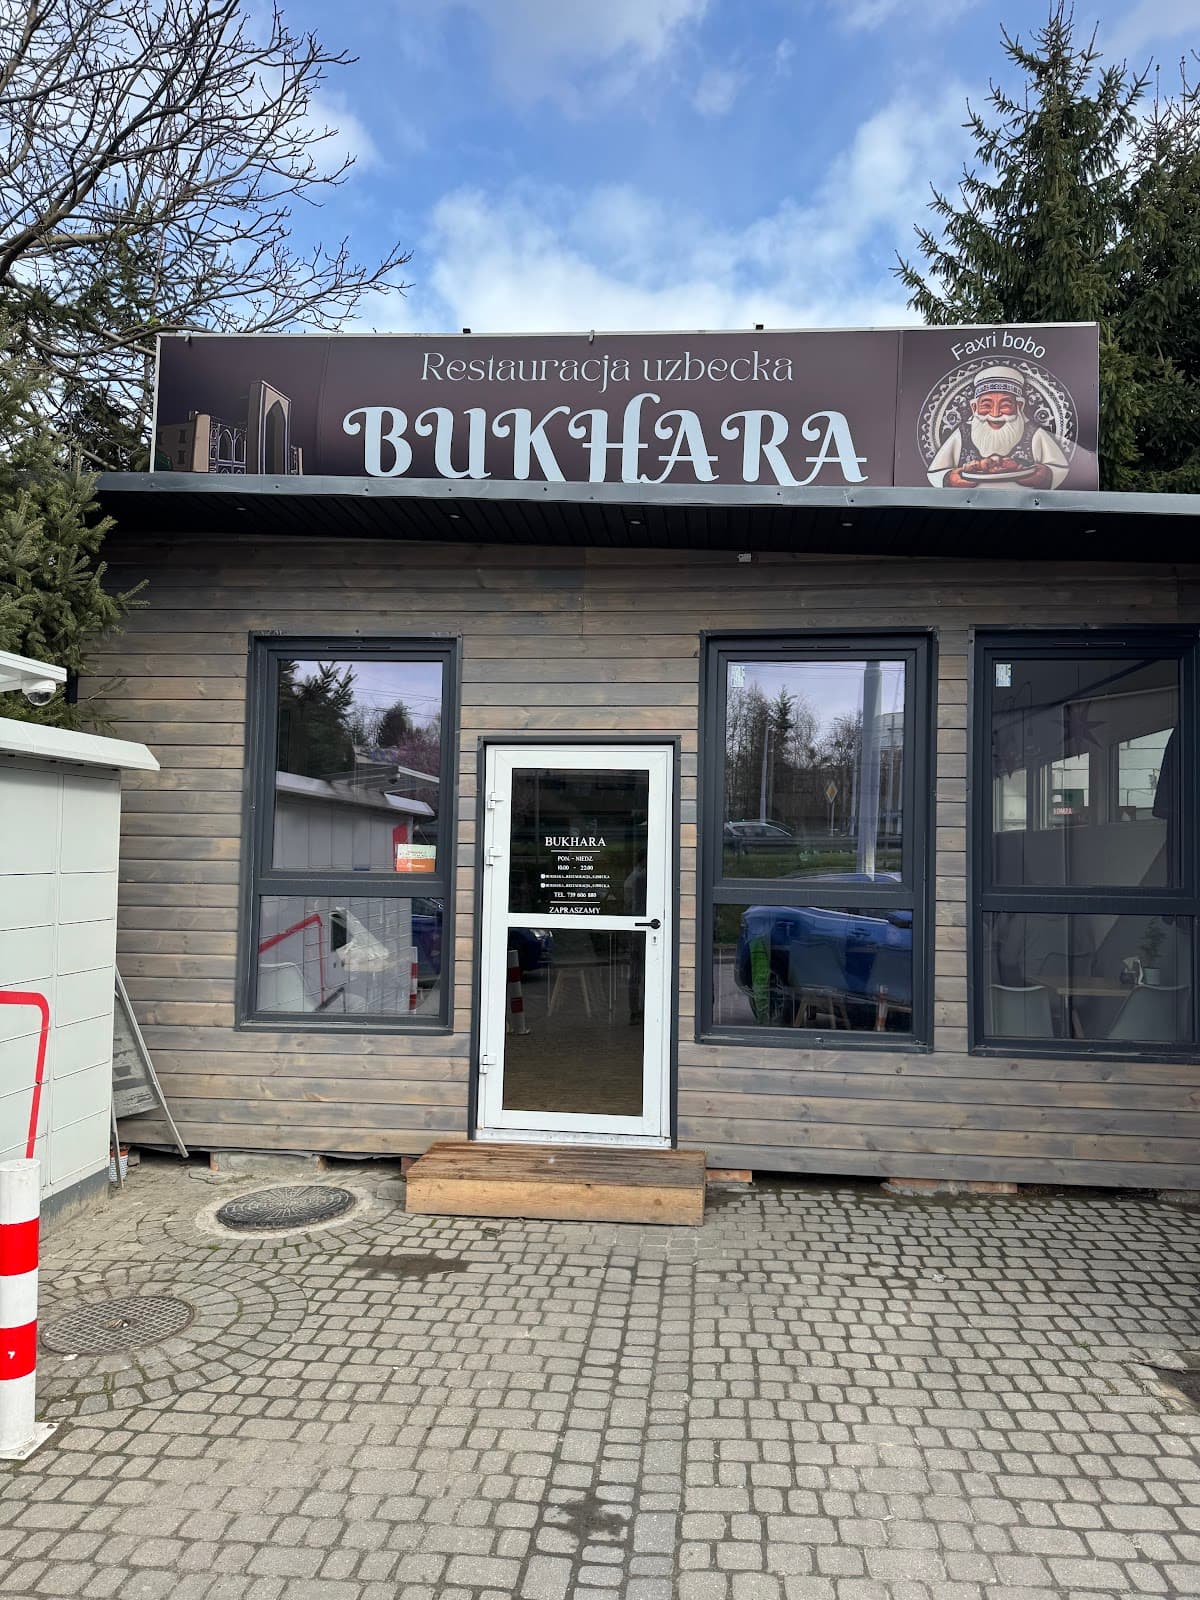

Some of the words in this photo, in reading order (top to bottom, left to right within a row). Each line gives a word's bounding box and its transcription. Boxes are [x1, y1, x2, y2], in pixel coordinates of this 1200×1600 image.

[951, 332, 997, 361] Faxri
[1002, 331, 1046, 359] bobo
[421, 351, 631, 393] Restauracja
[642, 350, 794, 382] uzbecka
[342, 392, 869, 487] BUKHARA
[544, 836, 606, 847] BUKHARA
[549, 906, 601, 914] ZAPRASZAMY
